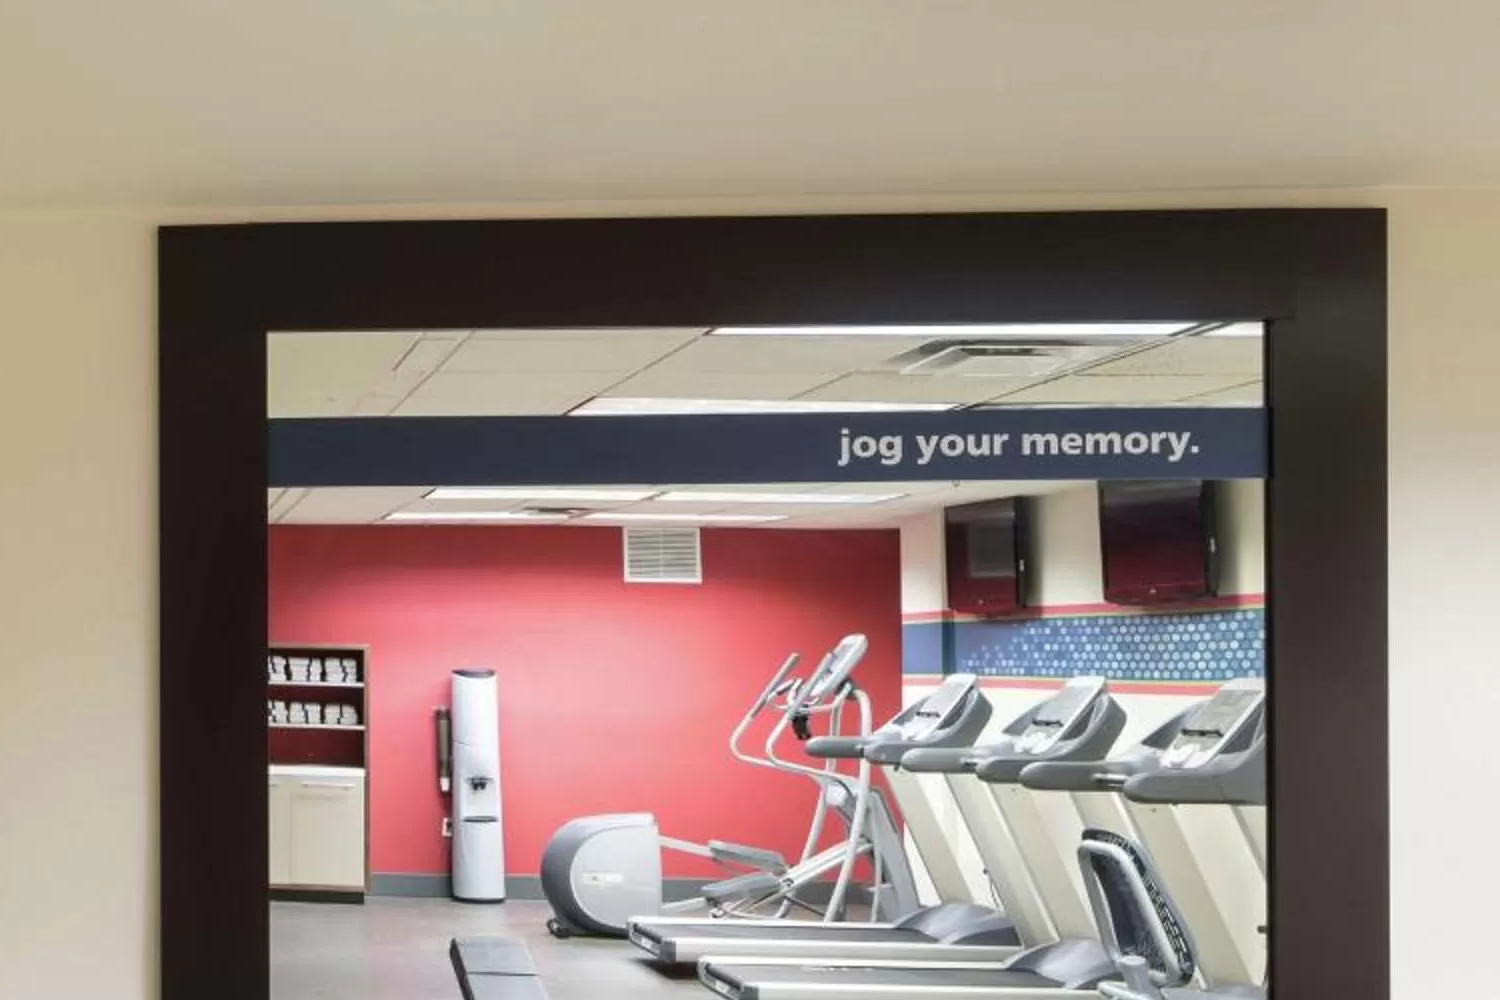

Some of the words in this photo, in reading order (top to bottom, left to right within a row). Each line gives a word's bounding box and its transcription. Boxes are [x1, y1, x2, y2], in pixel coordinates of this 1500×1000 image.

[837, 429, 903, 466] jog
[915, 433, 1009, 465] your
[1022, 431, 1199, 462] memory.
